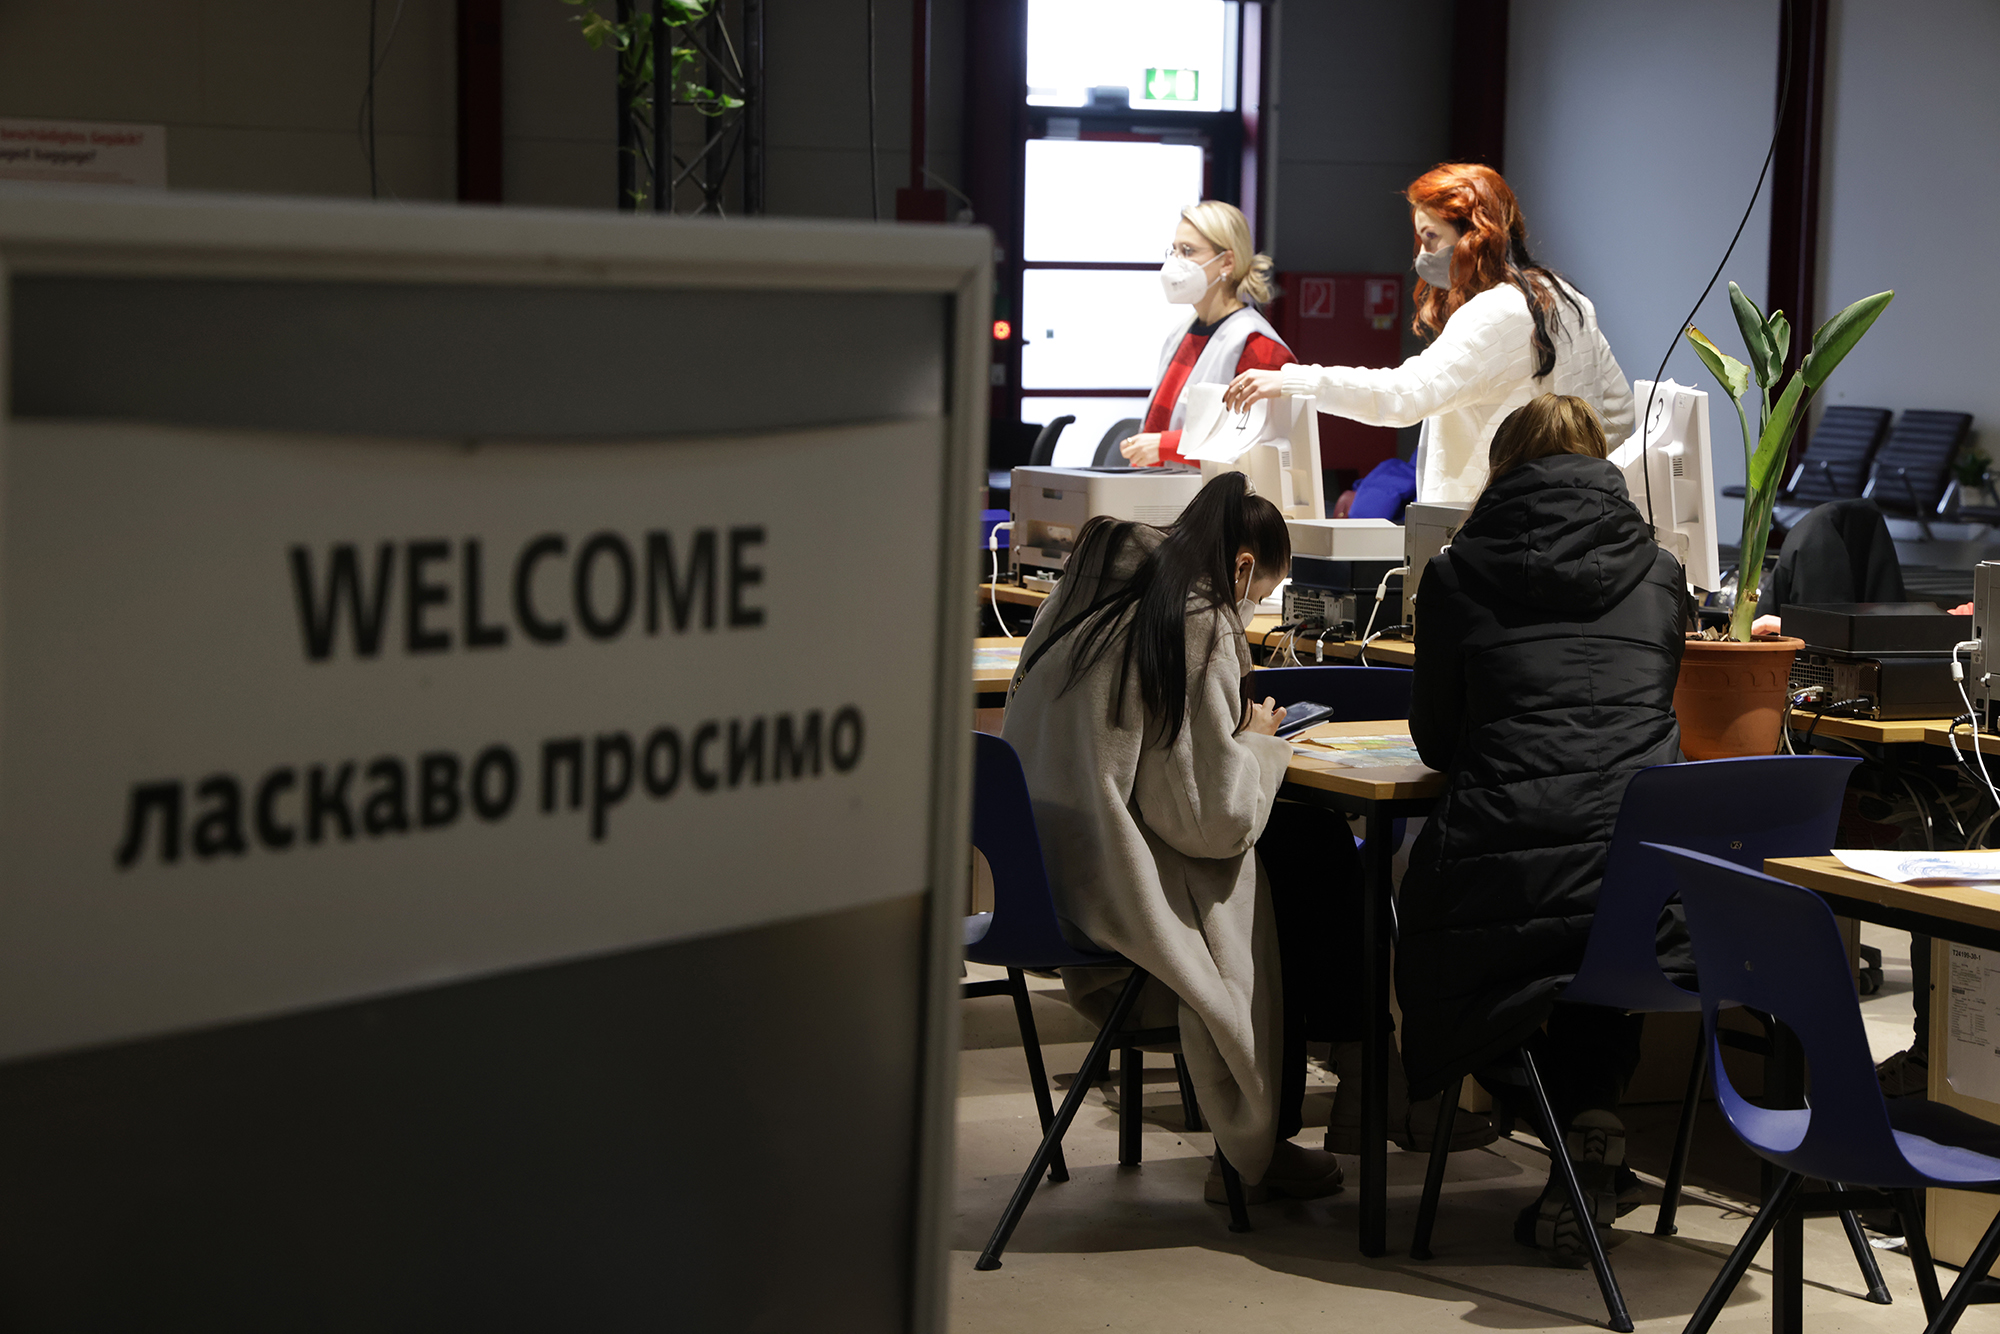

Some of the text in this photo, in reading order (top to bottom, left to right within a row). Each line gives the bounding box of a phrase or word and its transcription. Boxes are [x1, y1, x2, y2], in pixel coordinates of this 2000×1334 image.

[1647, 397, 1664, 435] 3
[287, 525, 765, 663] WELCOME
[113, 704, 865, 872] ласкаво просимо
